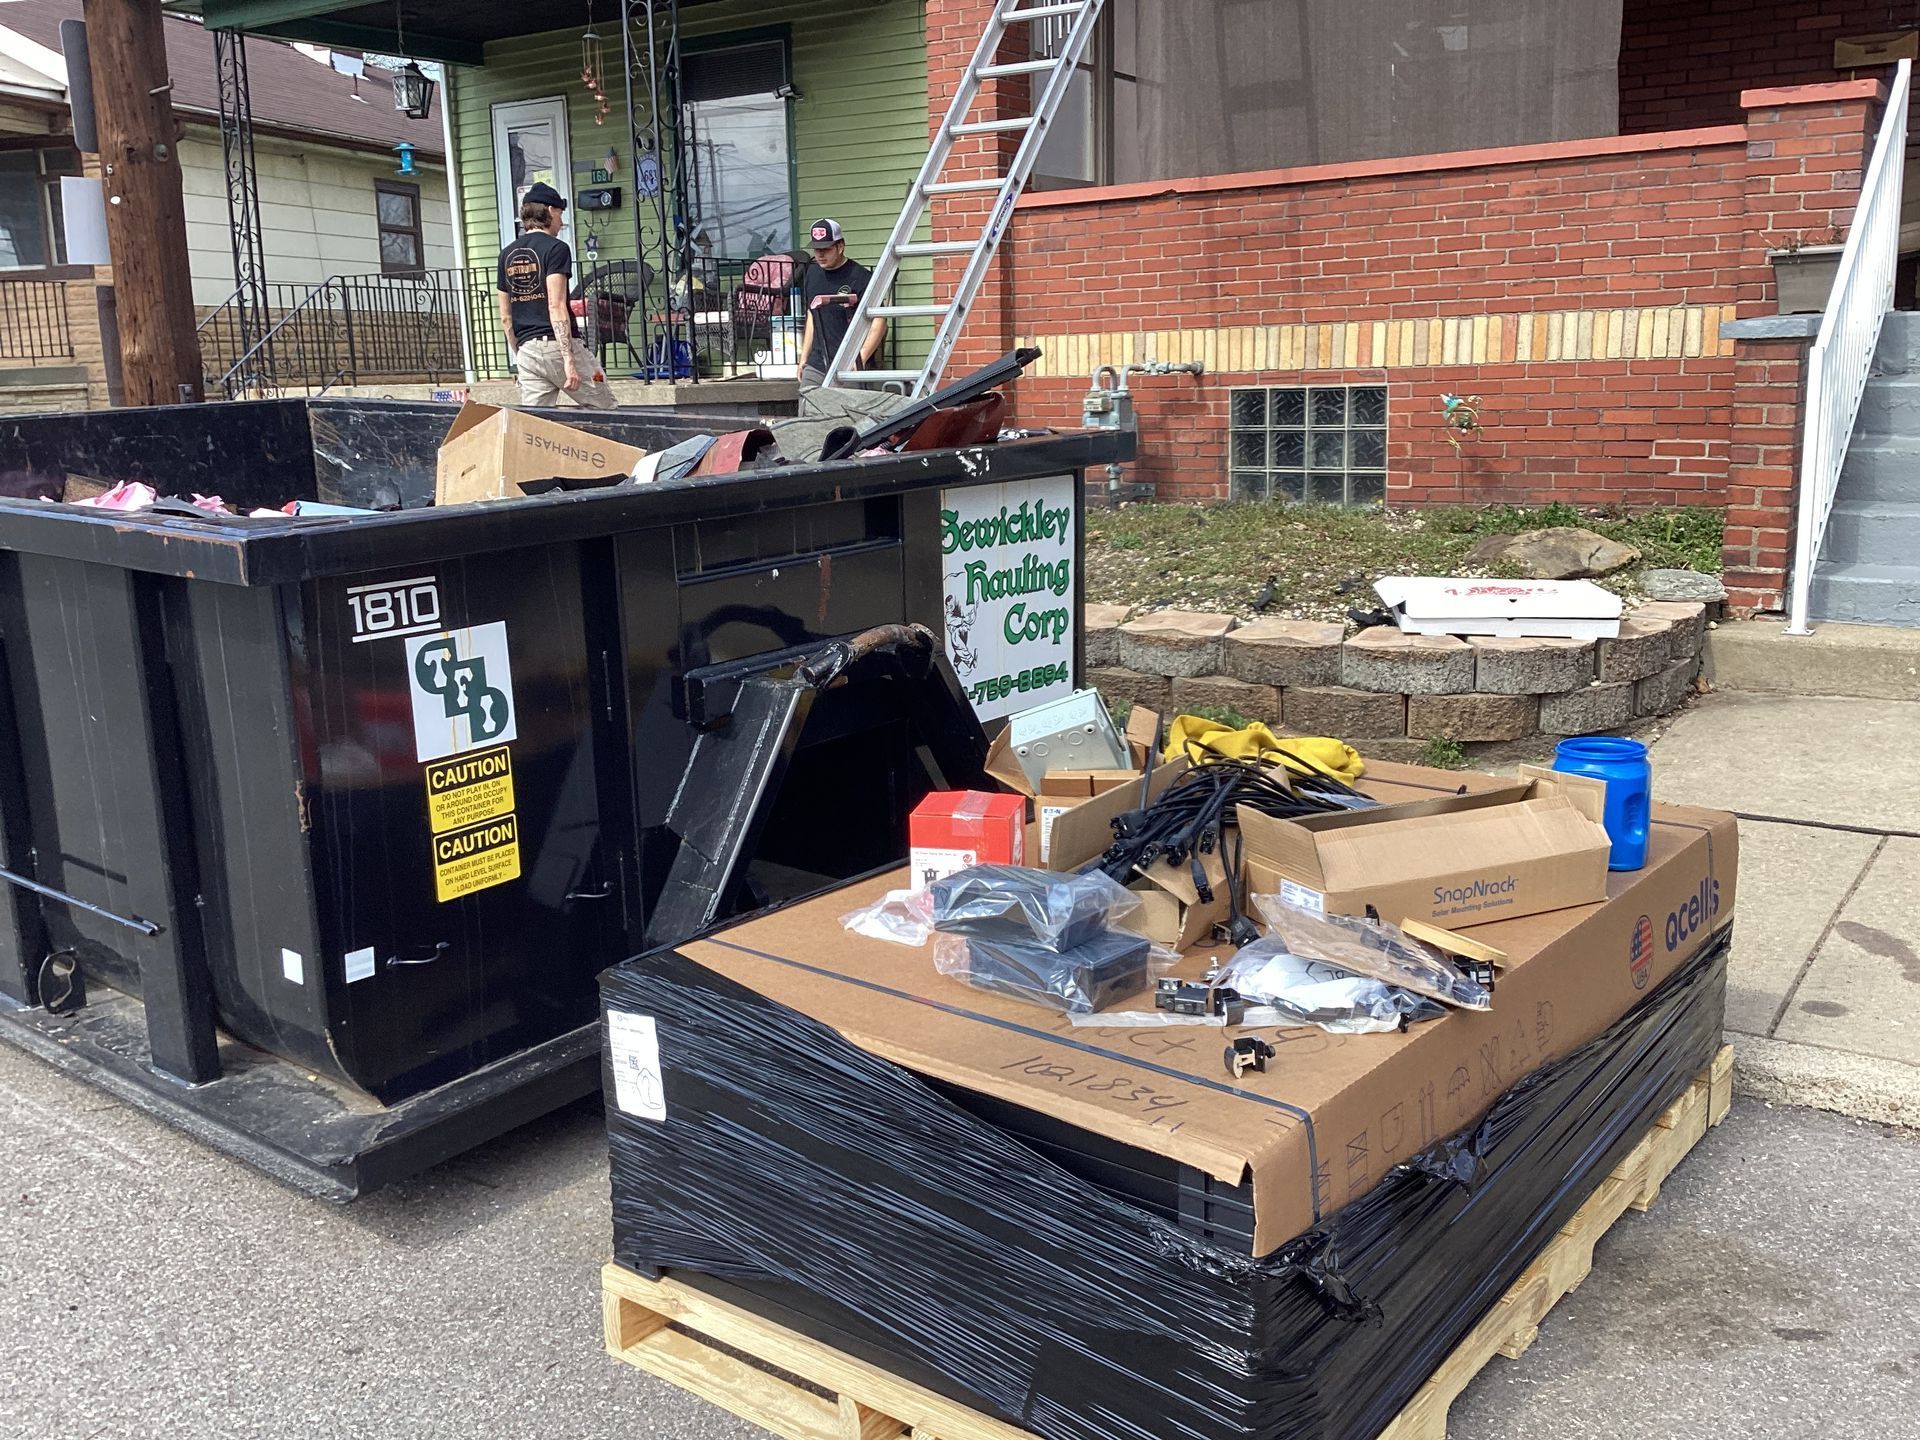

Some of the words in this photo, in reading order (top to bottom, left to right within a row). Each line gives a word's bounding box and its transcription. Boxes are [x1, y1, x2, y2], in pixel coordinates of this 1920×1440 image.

[524, 432, 589, 463] ENPHASE
[940, 499, 1070, 554] Sewickley
[348, 584, 440, 633] 1810
[1004, 602, 1069, 646] Corp
[962, 660, 1069, 706] -759-8894
[432, 754, 506, 788] CAUTION
[436, 803, 445, 812] OR
[446, 797, 473, 809] AROUND
[473, 793, 483, 802] OR
[483, 786, 508, 799] OCCUPY
[442, 793, 451, 802] DO
[452, 789, 466, 799] NOT
[466, 785, 483, 796] PLAY
[491, 780, 501, 788] ON
[441, 810, 456, 819] THIS
[456, 800, 491, 815] CONTAINER
[492, 796, 504, 805] FOR
[453, 816, 465, 826] ANY
[467, 807, 495, 821] PURPOSE
[440, 822, 513, 859] CAUTION
[440, 862, 471, 877] CONTAINER
[471, 857, 486, 866] MUST
[495, 848, 516, 859] PLACED
[445, 878, 454, 886] ON
[454, 873, 470, 883] HARD
[470, 867, 487, 878] LEVEL
[488, 859, 512, 873] SURFACE
[1431, 909, 1449, 918] Solar
[1450, 903, 1482, 913] Mounting
[1483, 898, 1514, 909] Solutions
